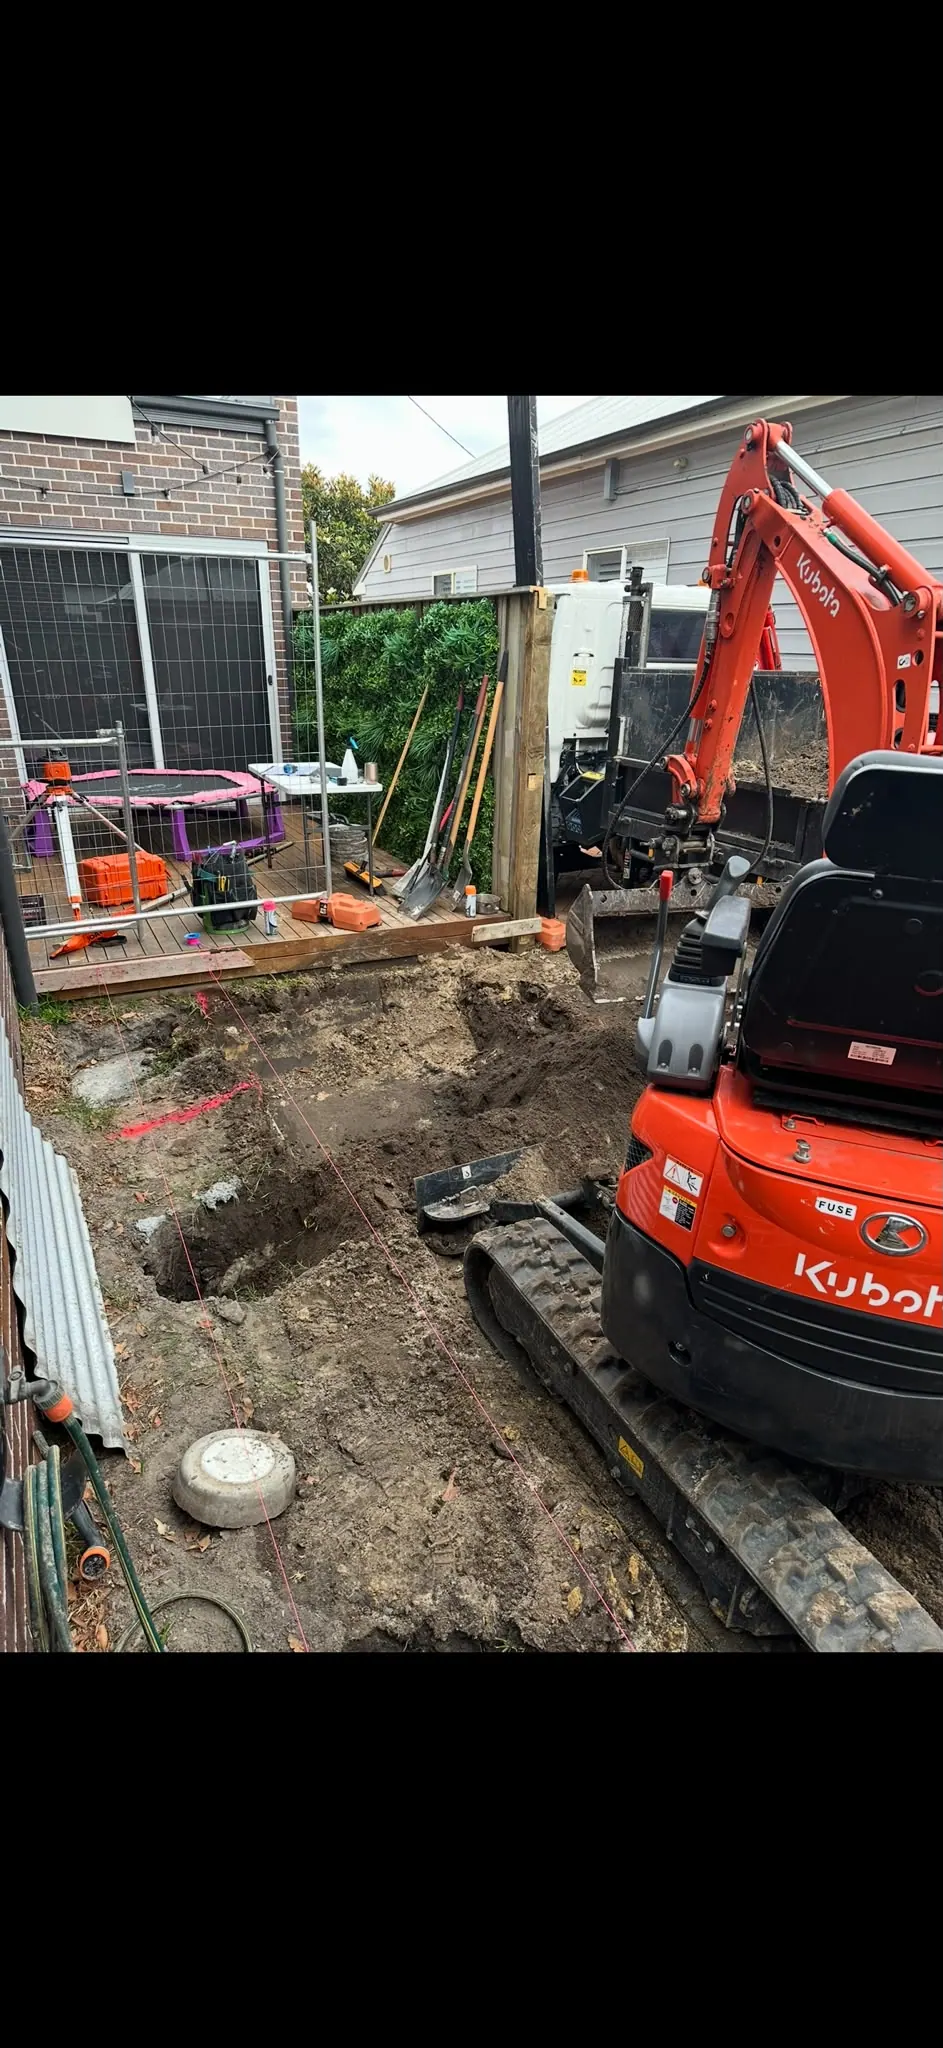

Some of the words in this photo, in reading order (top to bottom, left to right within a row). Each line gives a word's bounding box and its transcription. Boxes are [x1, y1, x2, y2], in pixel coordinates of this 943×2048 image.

[797, 552, 840, 618] Kubota
[818, 1200, 853, 1217] FUSE
[794, 1252, 943, 1318] Kubot
